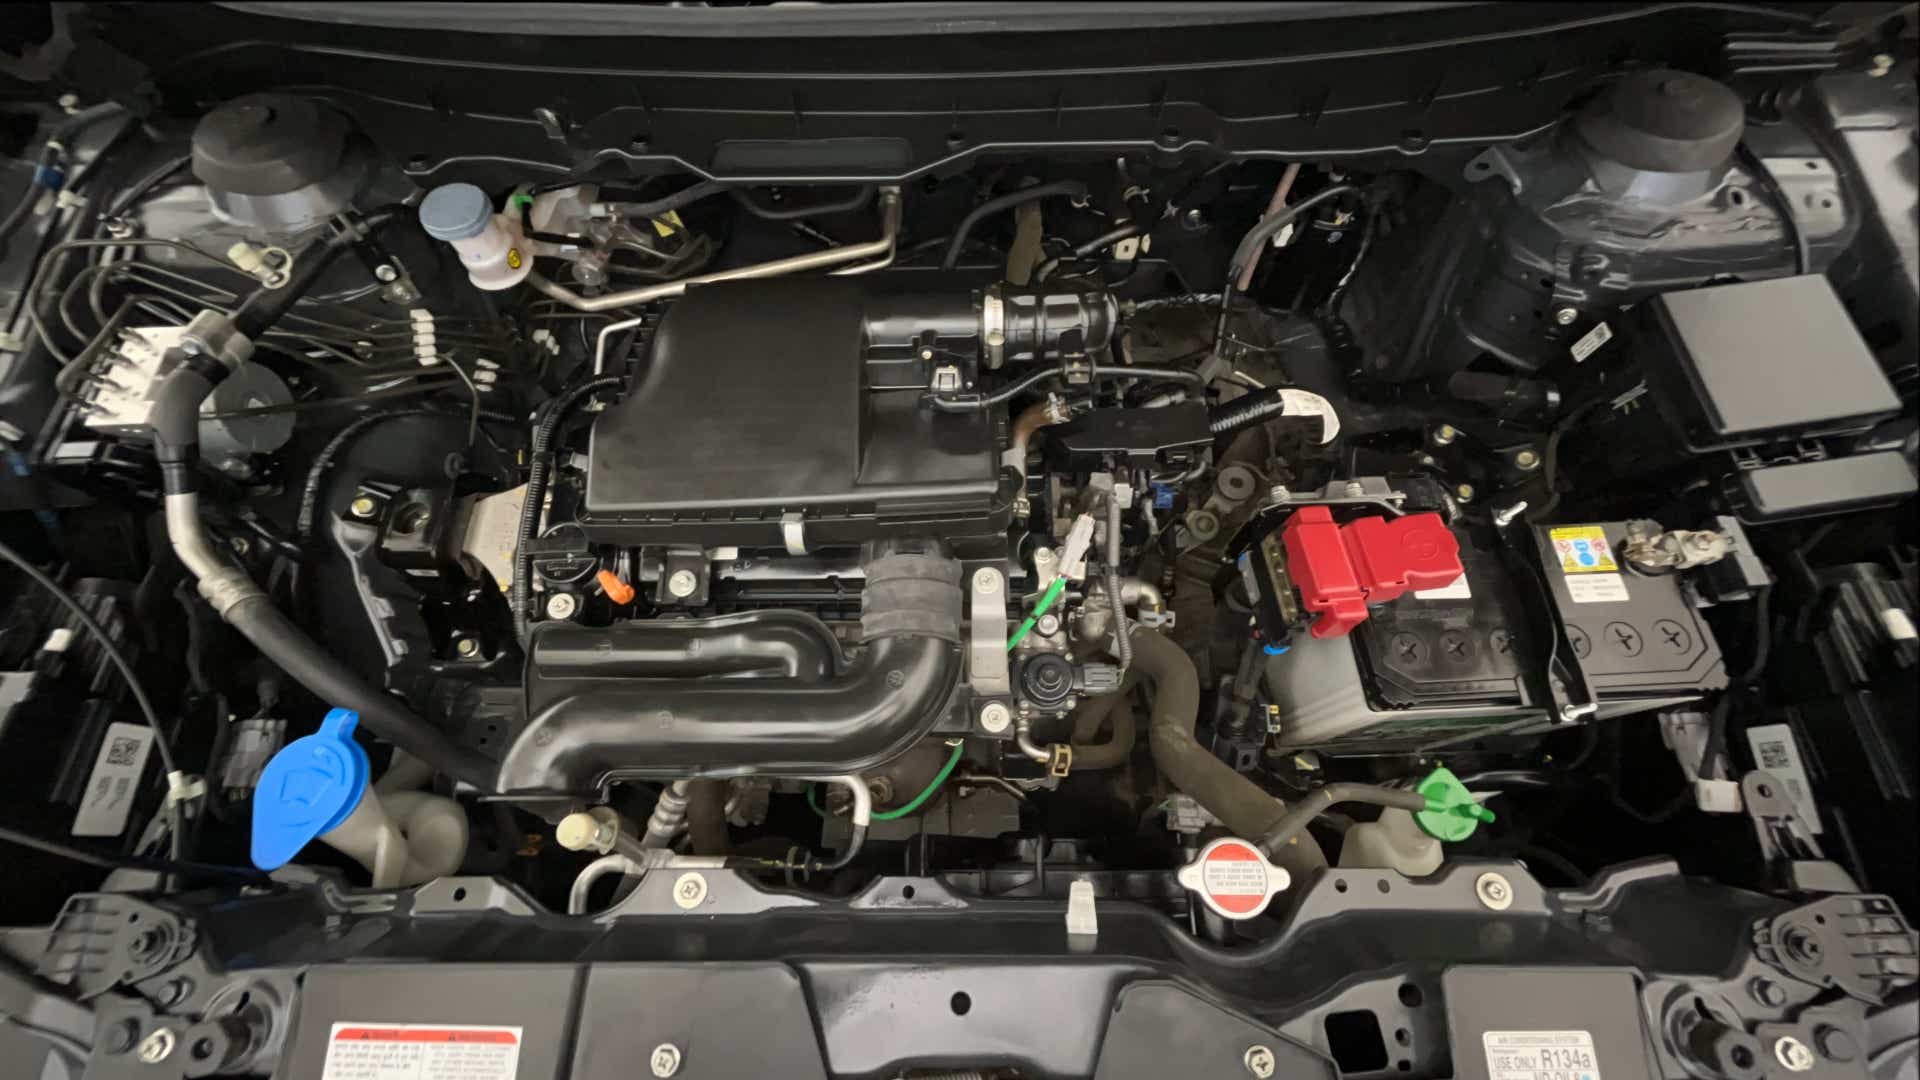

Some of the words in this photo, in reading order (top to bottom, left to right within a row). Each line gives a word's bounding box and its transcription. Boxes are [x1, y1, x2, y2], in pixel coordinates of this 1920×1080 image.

[1493, 1056, 1512, 1069] USE
[1514, 1056, 1536, 1068] ONLY
[1541, 1048, 1591, 1068] R134a
